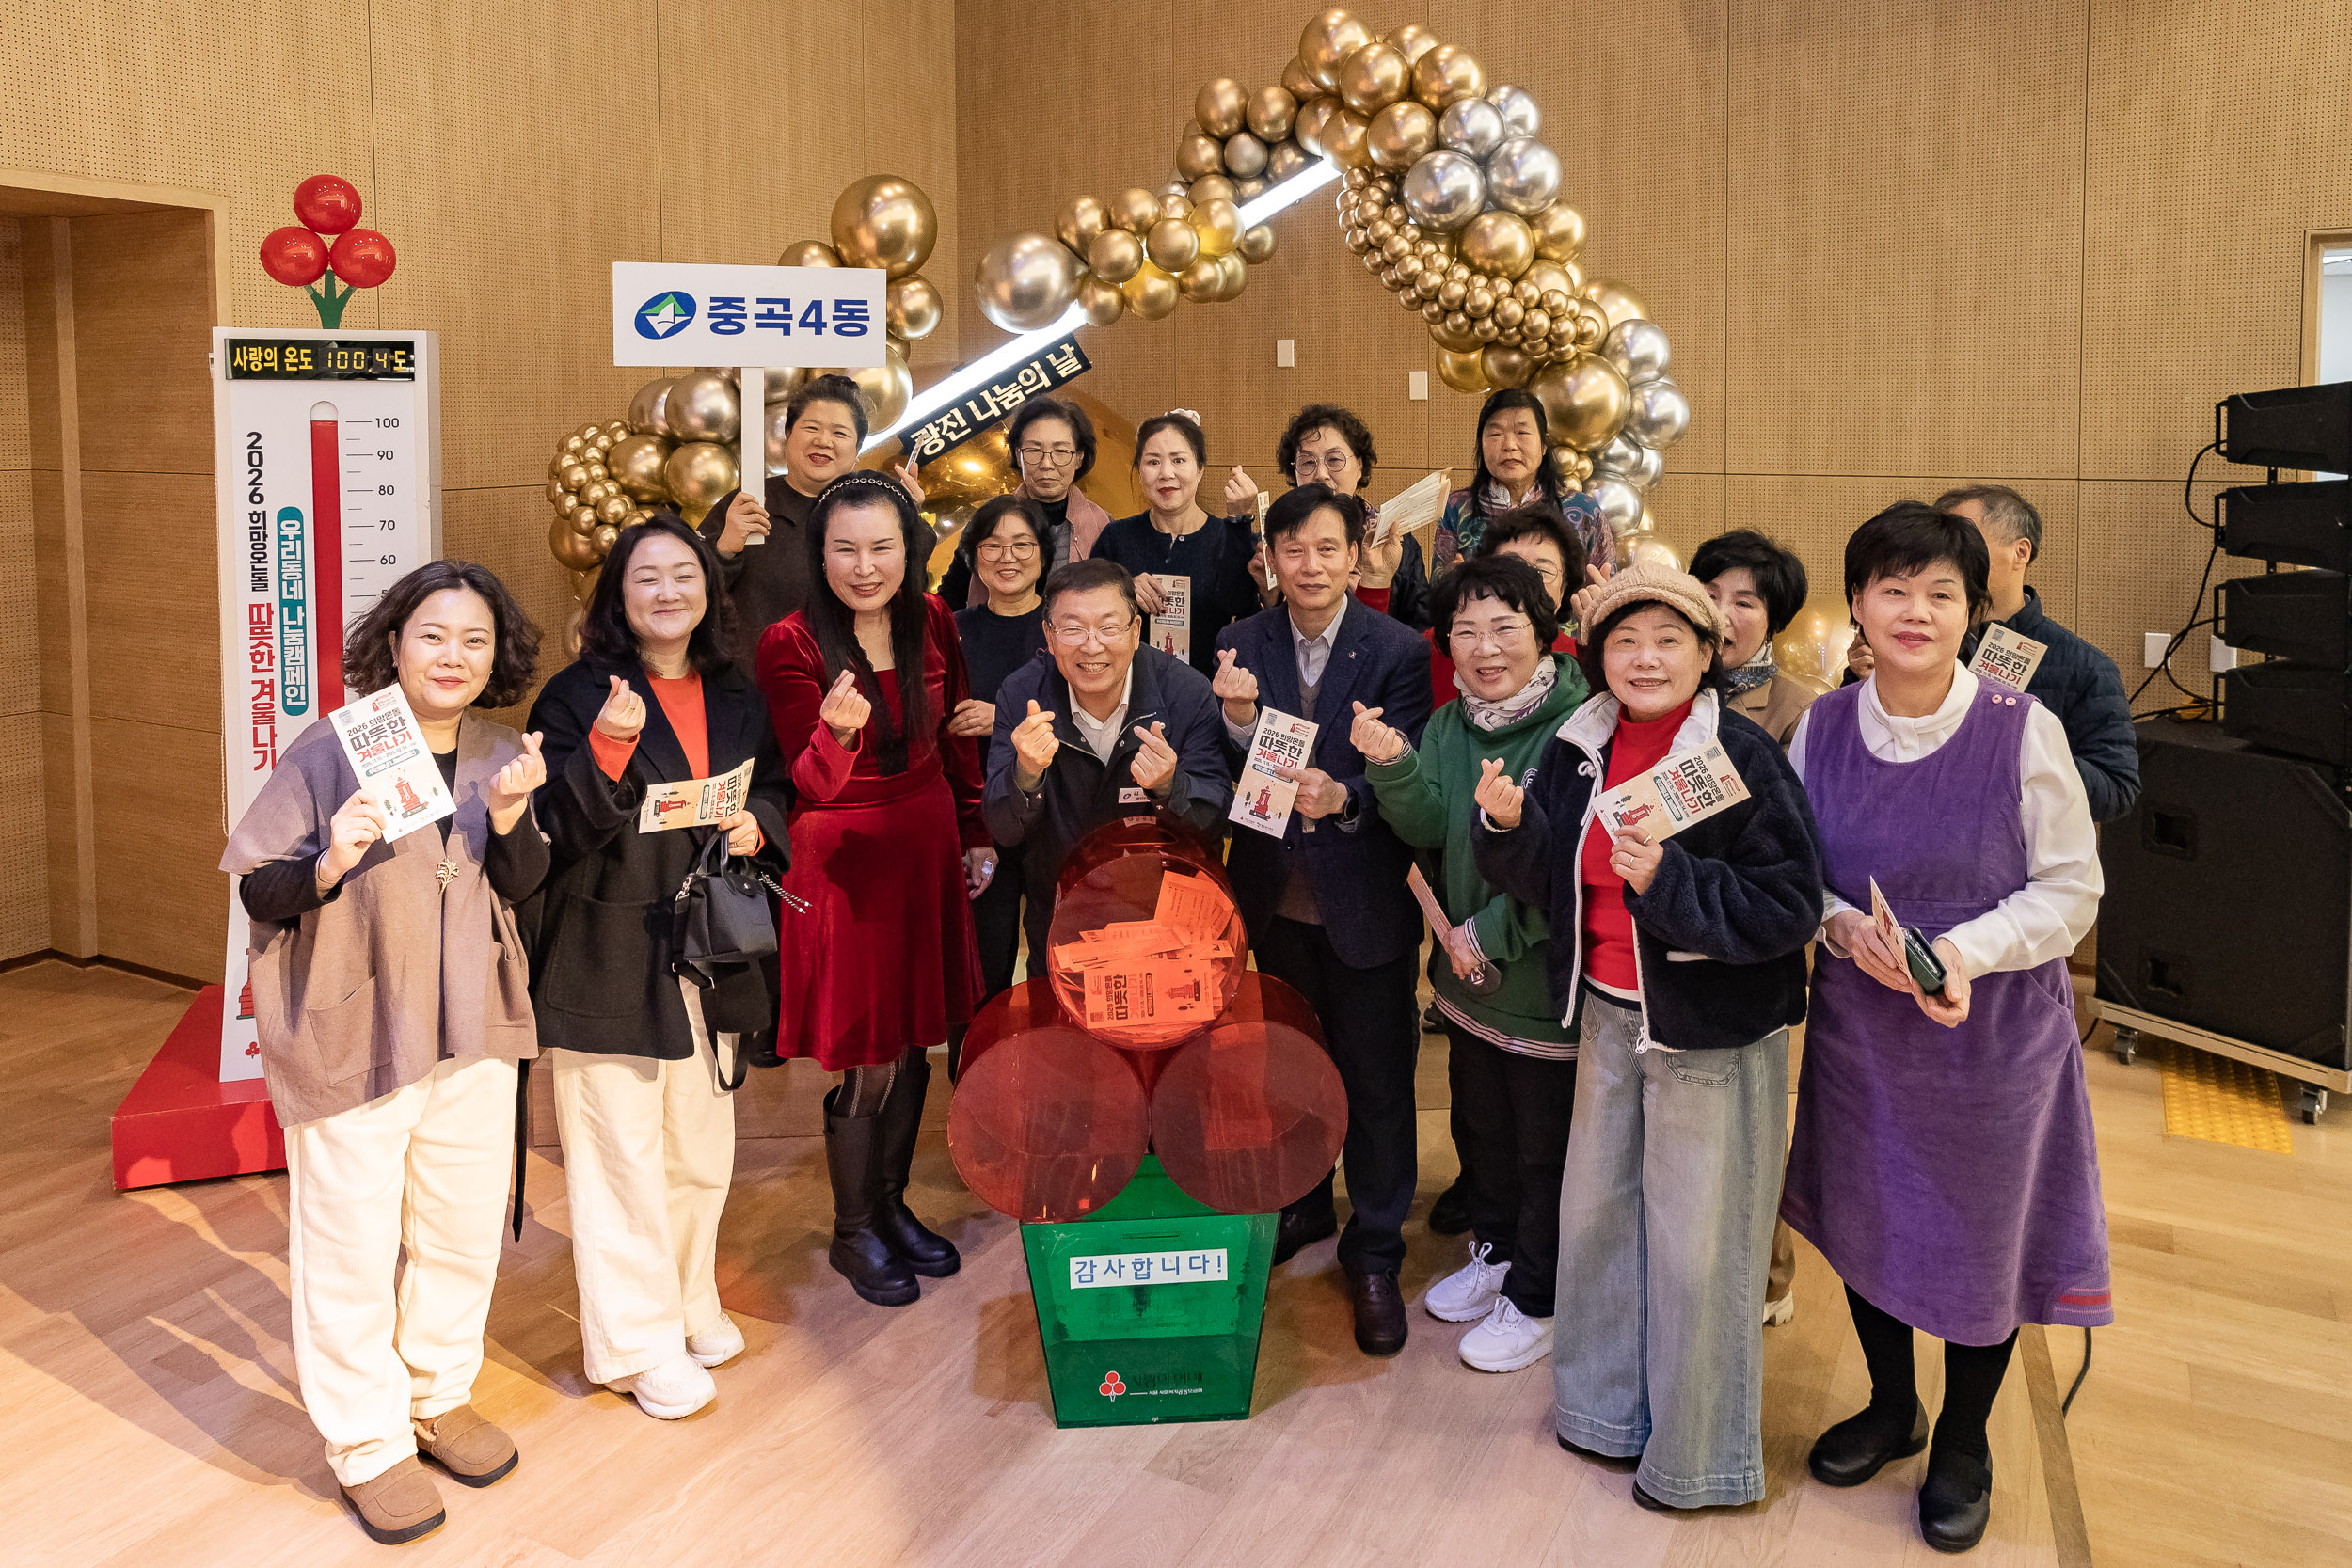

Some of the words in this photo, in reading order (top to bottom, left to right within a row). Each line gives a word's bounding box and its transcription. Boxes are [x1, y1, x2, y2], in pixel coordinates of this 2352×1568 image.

[707, 296, 870, 338] 중곡4동
[233, 346, 278, 372] 사랑의
[284, 347, 313, 372] 온도
[910, 407, 972, 456] 광진
[965, 360, 1052, 418] 나눔의
[1046, 343, 1082, 378] 날
[375, 418, 400, 428] 100
[246, 432, 265, 505] 2026
[377, 450, 394, 461] 90
[378, 484, 395, 496] 80
[379, 520, 396, 531] 70
[249, 510, 269, 593] 희망온돌
[279, 518, 304, 601] 우리동네
[380, 555, 397, 565] 60
[1165, 596, 1185, 607] 뜻한
[248, 602, 275, 673] 따뜻한
[1988, 642, 2005, 654] 2026
[282, 606, 307, 706] 나눔캠페인
[1982, 648, 2027, 676] 따뜻한
[1978, 659, 2021, 685] 겨울나기
[251, 678, 278, 771] 겨울나기
[347, 722, 368, 736] 2026
[350, 716, 407, 752] 따뜻한
[357, 730, 412, 763] 겨울나기
[1256, 748, 1298, 769] 겨울나기
[1259, 735, 1303, 761] 따뜻한
[1694, 755, 1708, 774] 2026
[715, 780, 727, 818] 겨울나기
[725, 775, 737, 816] 따뜻한
[1667, 767, 1702, 815] 겨울나기
[1678, 758, 1716, 809] 따뜻한
[1113, 974, 1129, 1021] 따뜻한
[1074, 1254, 1222, 1284] 감사합니다!
